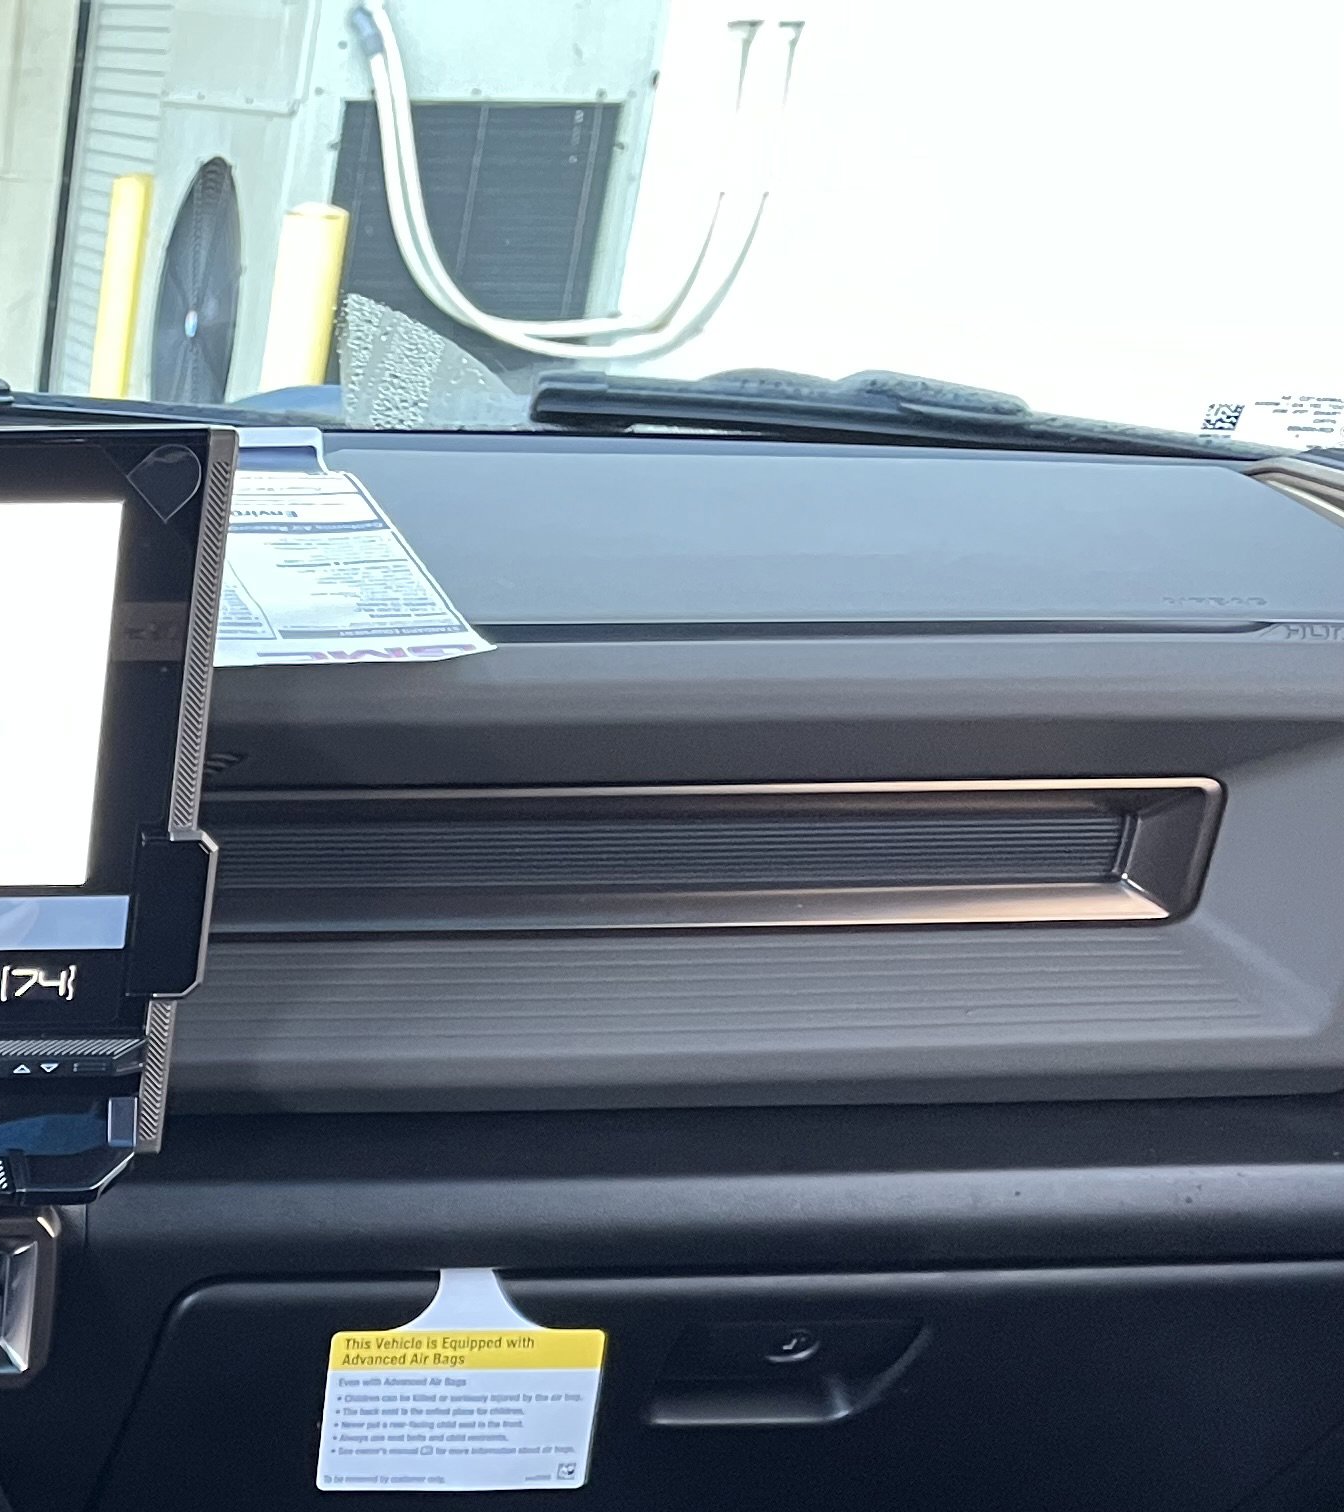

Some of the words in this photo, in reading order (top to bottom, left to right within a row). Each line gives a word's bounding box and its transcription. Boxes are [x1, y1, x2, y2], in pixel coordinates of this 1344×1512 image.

[345, 1337, 372, 1350] This
[375, 1337, 423, 1350] Vehicle
[426, 1337, 438, 1349] is
[441, 1336, 503, 1352] Equipped
[506, 1335, 536, 1349] with
[341, 1353, 407, 1366] Advanced
[410, 1353, 430, 1365] Air
[433, 1353, 466, 1368] Bags
